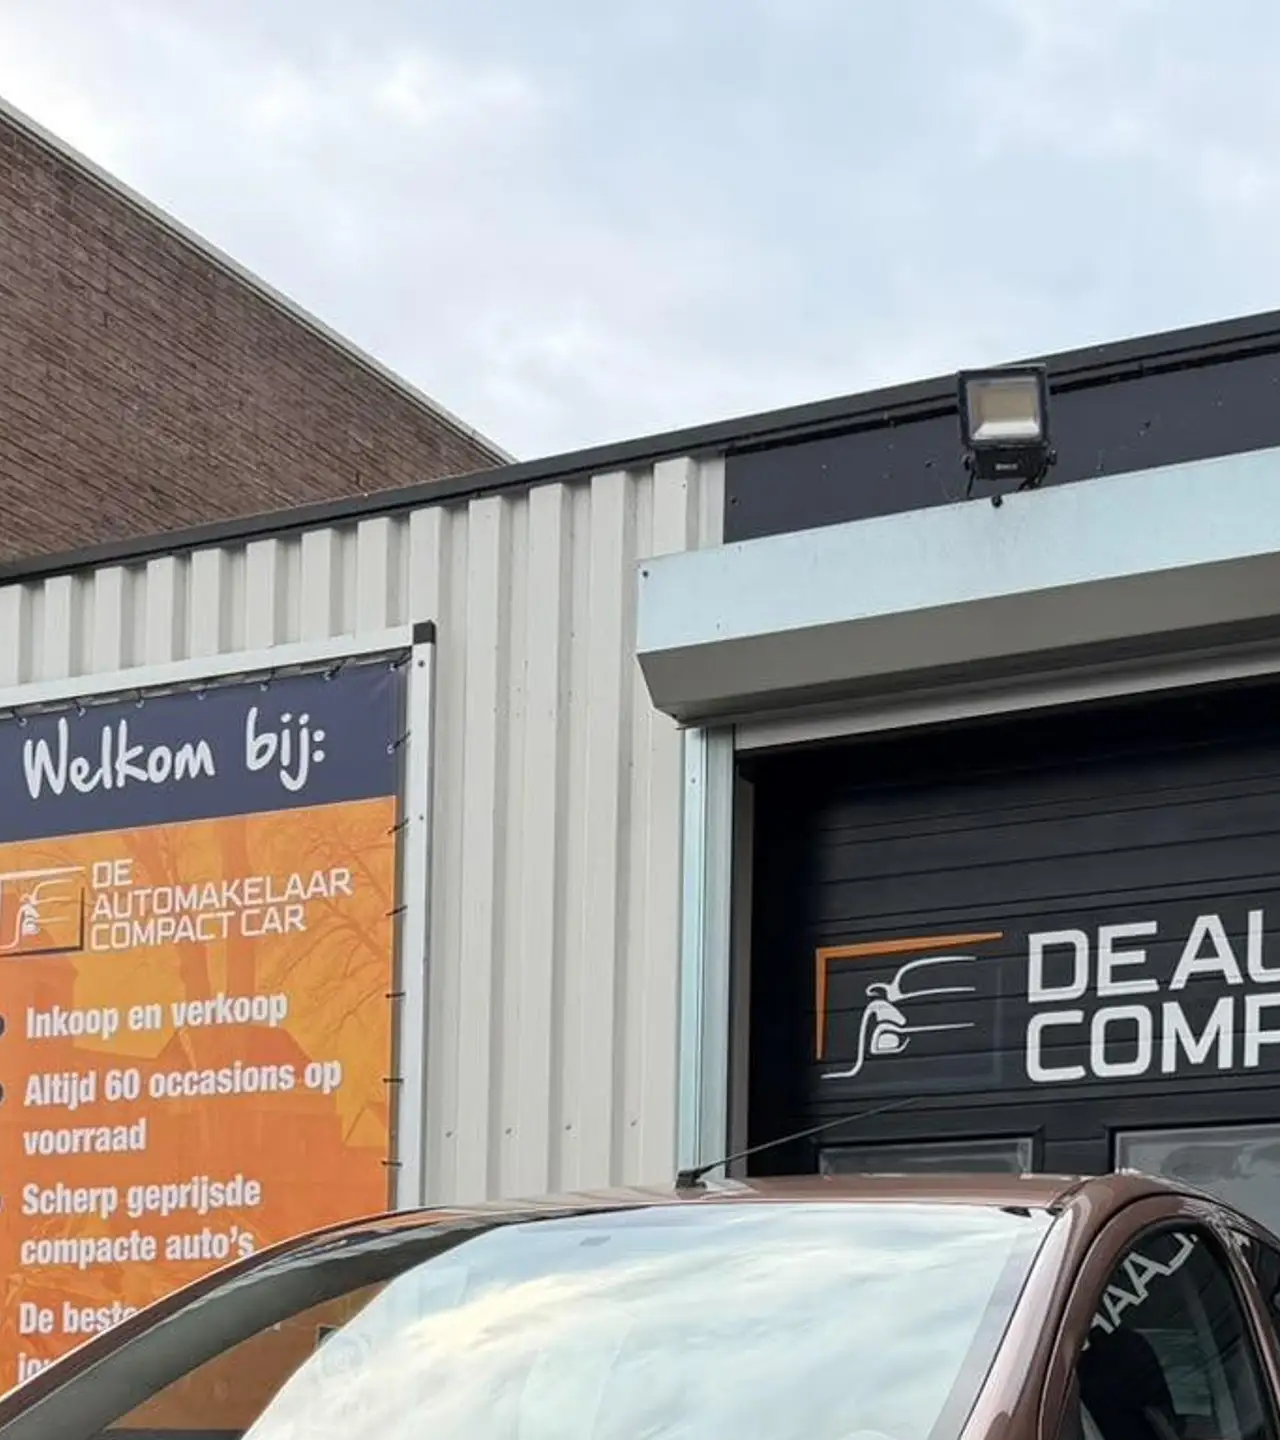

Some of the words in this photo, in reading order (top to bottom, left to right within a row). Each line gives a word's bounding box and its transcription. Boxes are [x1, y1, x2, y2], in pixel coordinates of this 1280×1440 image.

[23, 717, 216, 799] Welkom
[245, 707, 325, 791] bij:
[90, 867, 353, 922] AUTOMAKELAAR
[92, 858, 134, 889] DE
[90, 912, 236, 953] COMPACT
[241, 907, 307, 938] CAR
[1027, 920, 1158, 1002] DE
[26, 1004, 119, 1041] Inkoop
[128, 1003, 161, 1031] en
[171, 993, 288, 1029] verkoop
[24, 1070, 97, 1111] Altijd
[105, 1069, 140, 1101] 60
[149, 1060, 295, 1097] occasions
[304, 1060, 342, 1094] op
[23, 1118, 147, 1157] voorraad
[22, 1183, 119, 1218] Scherp
[126, 1174, 262, 1216] geprijsde
[20, 1232, 157, 1270] compacte
[166, 1226, 256, 1260] auto's
[19, 1301, 55, 1334] De
